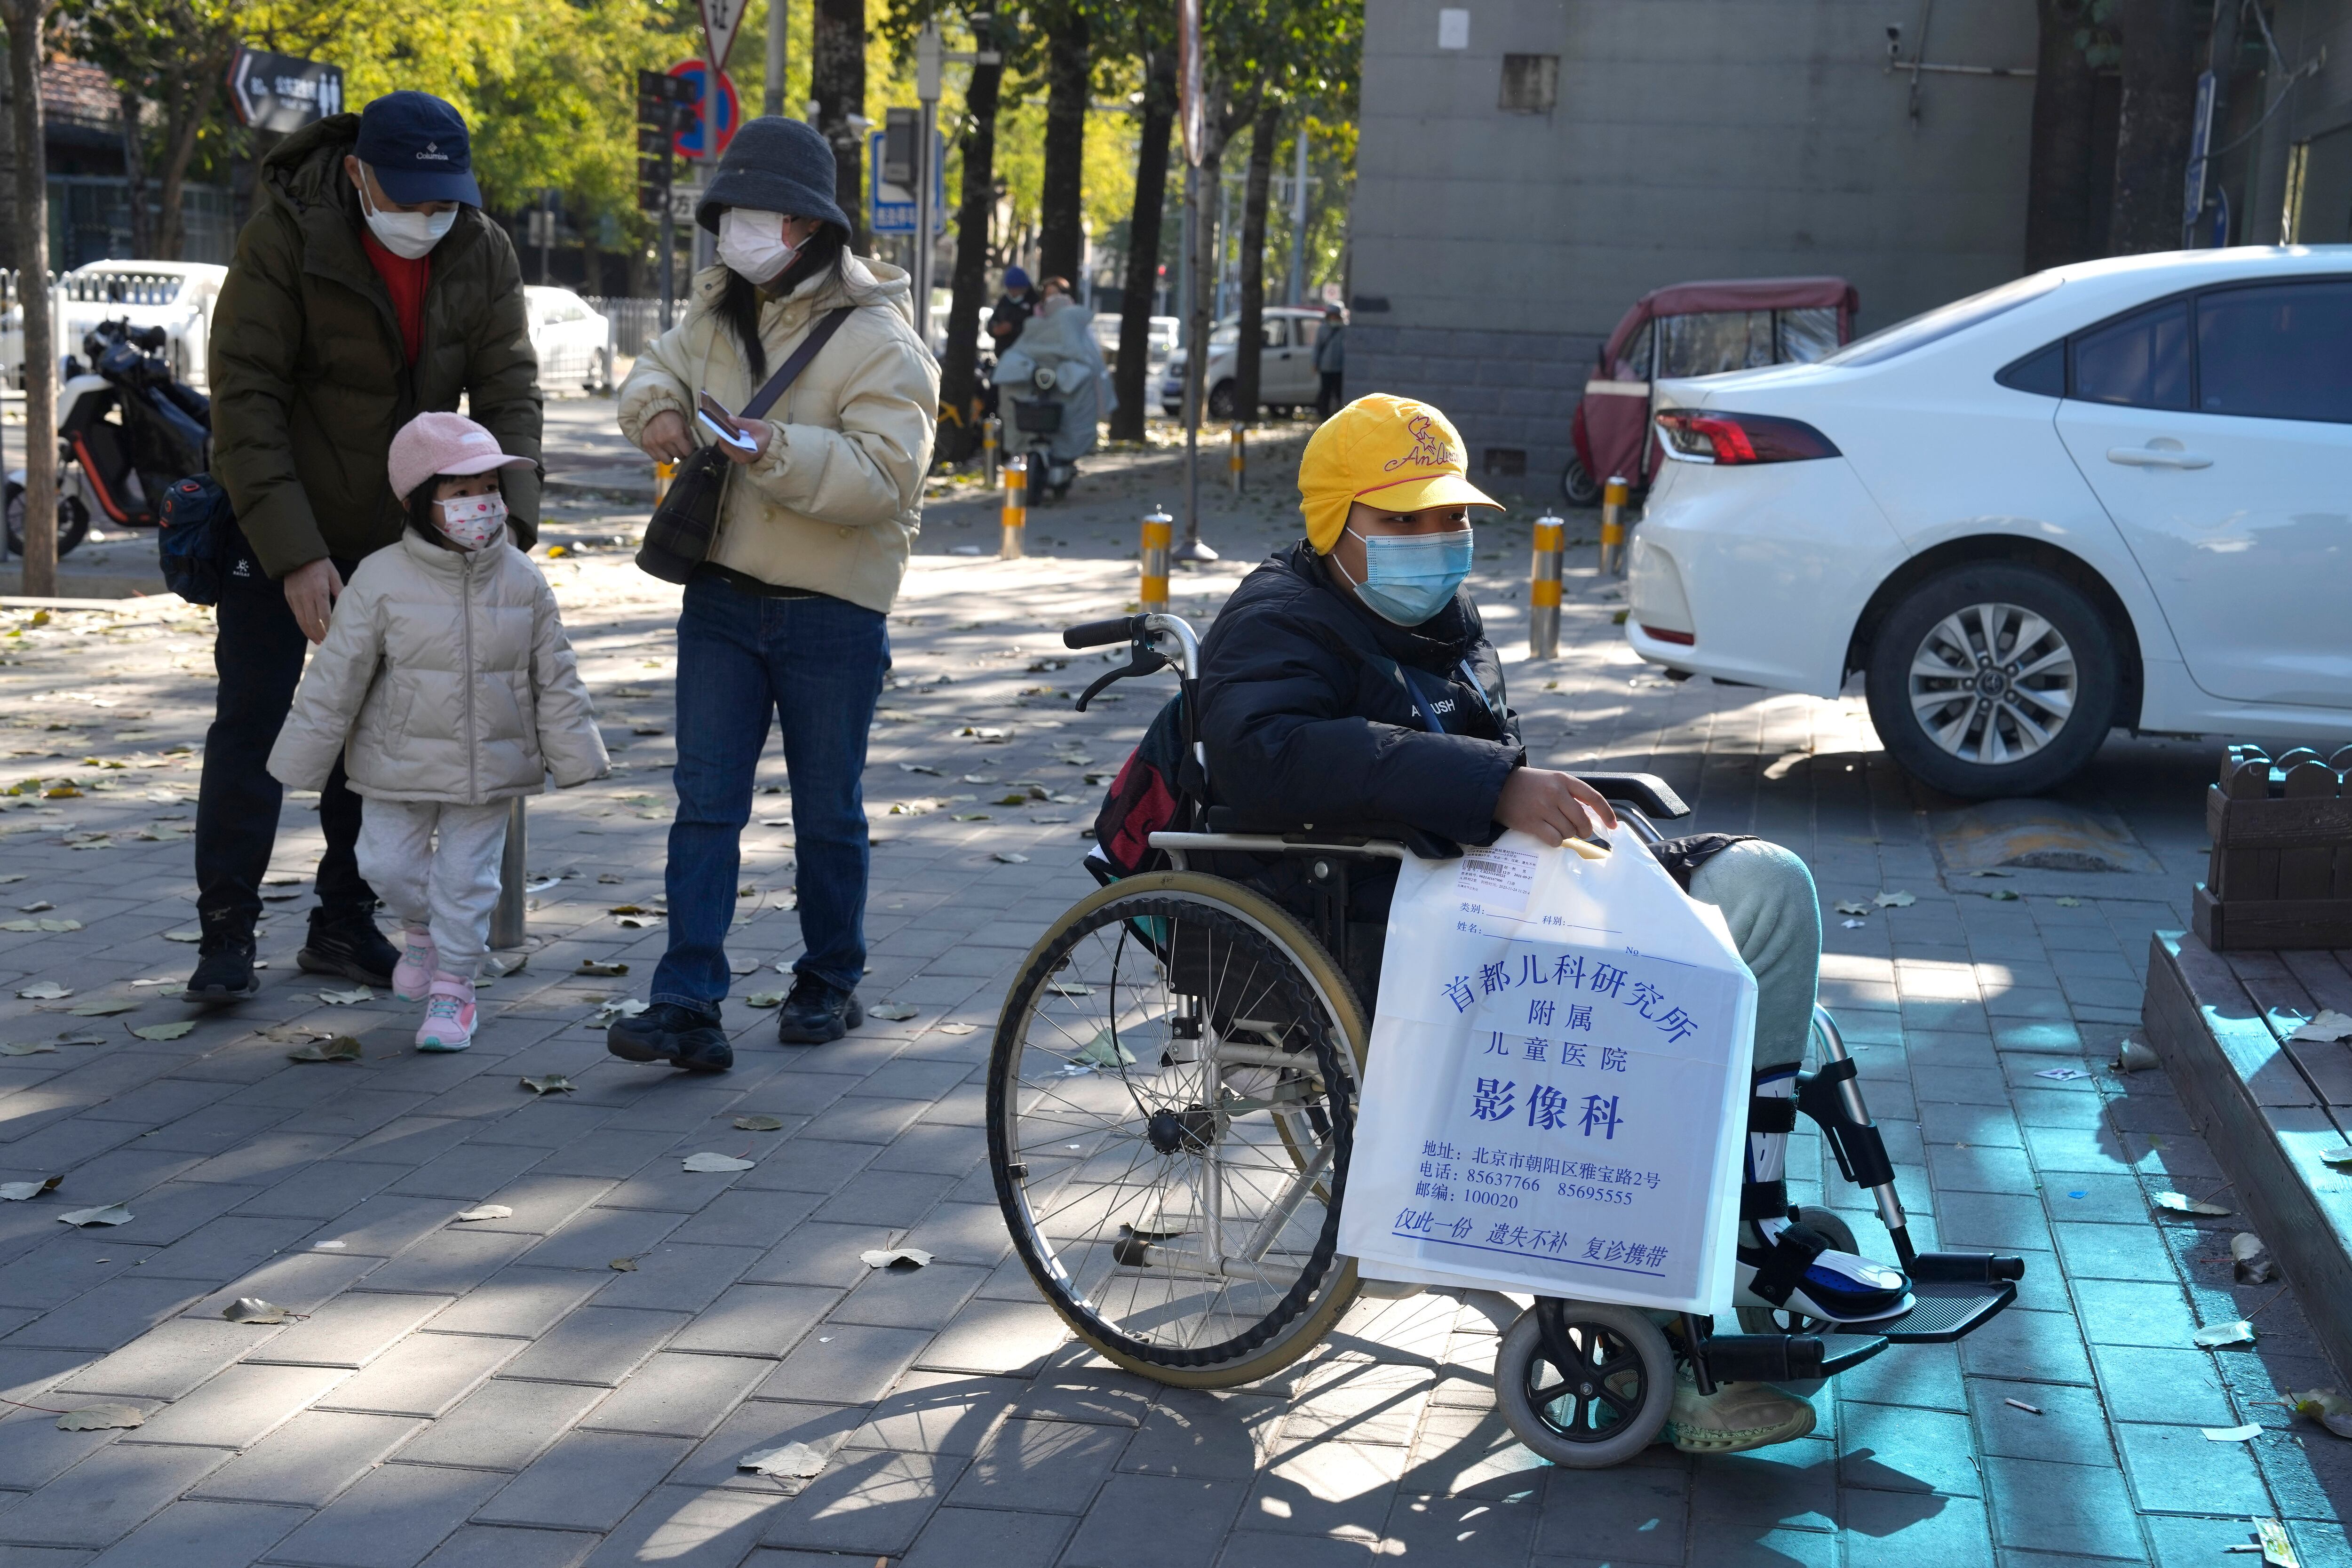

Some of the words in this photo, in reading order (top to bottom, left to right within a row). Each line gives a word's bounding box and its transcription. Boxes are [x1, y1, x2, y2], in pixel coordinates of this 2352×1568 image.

[416, 151, 449, 160] Columbia
[1412, 699, 1455, 717] AUSH
[1441, 954, 1698, 1043] 首都儿科研究所
[1528, 999, 1593, 1032] 附属
[1483, 1031, 1629, 1073] 儿童医院
[1470, 1077, 1624, 1140] 影像科
[1557, 1182, 1633, 1206] 85695555
[1394, 1207, 1473, 1239] 仅此一份
[1485, 1222, 1568, 1253] 遗失不补
[1581, 1236, 1669, 1268] 复诊携带
